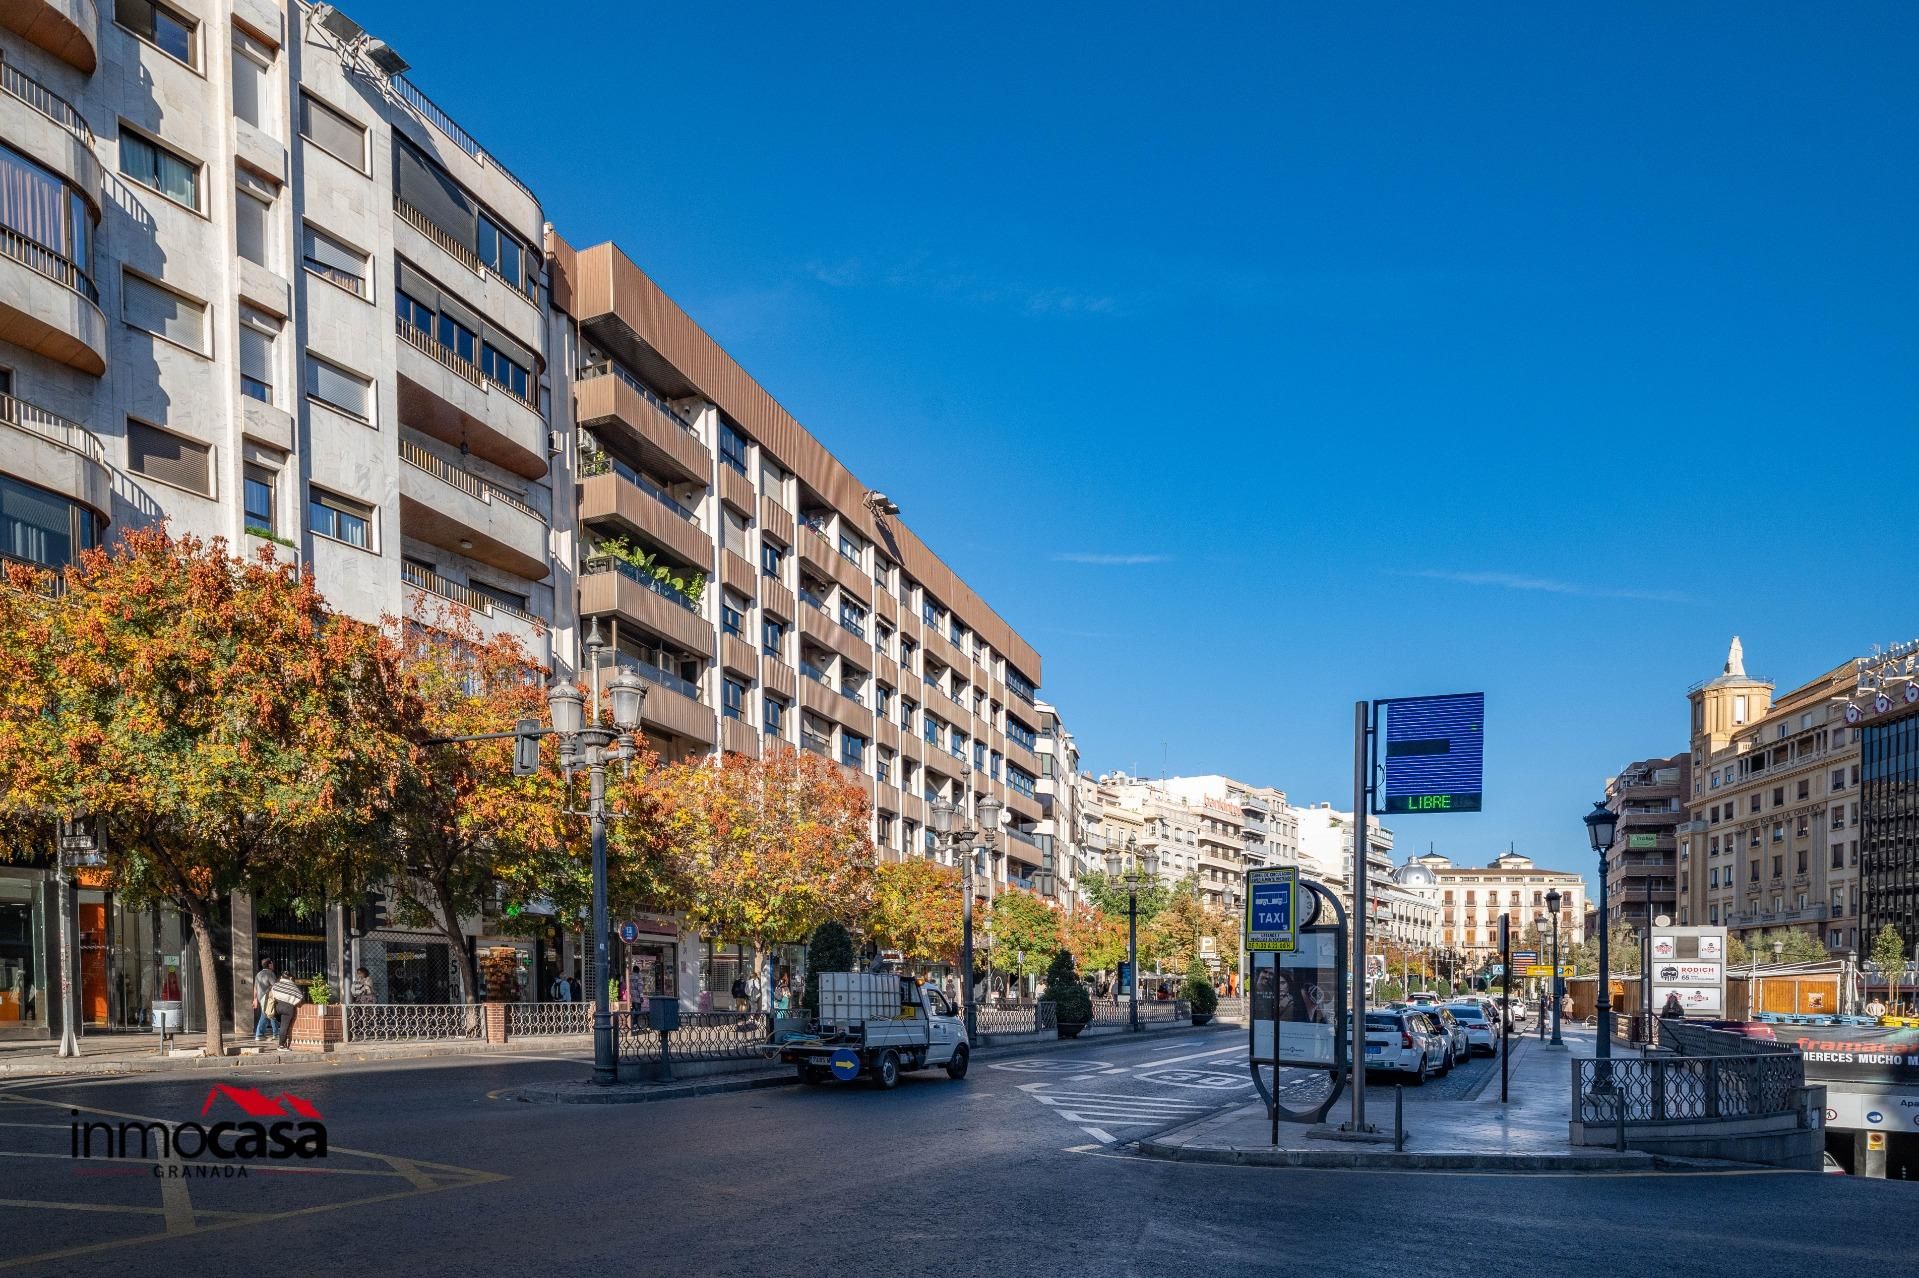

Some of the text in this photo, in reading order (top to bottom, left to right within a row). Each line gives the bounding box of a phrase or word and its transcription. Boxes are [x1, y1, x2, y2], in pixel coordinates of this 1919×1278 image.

[1408, 795, 1451, 809] LIBRE
[1258, 912, 1284, 924] TAXI
[449, 984, 460, 998] 10
[1858, 1054, 1903, 1065] MUCHO
